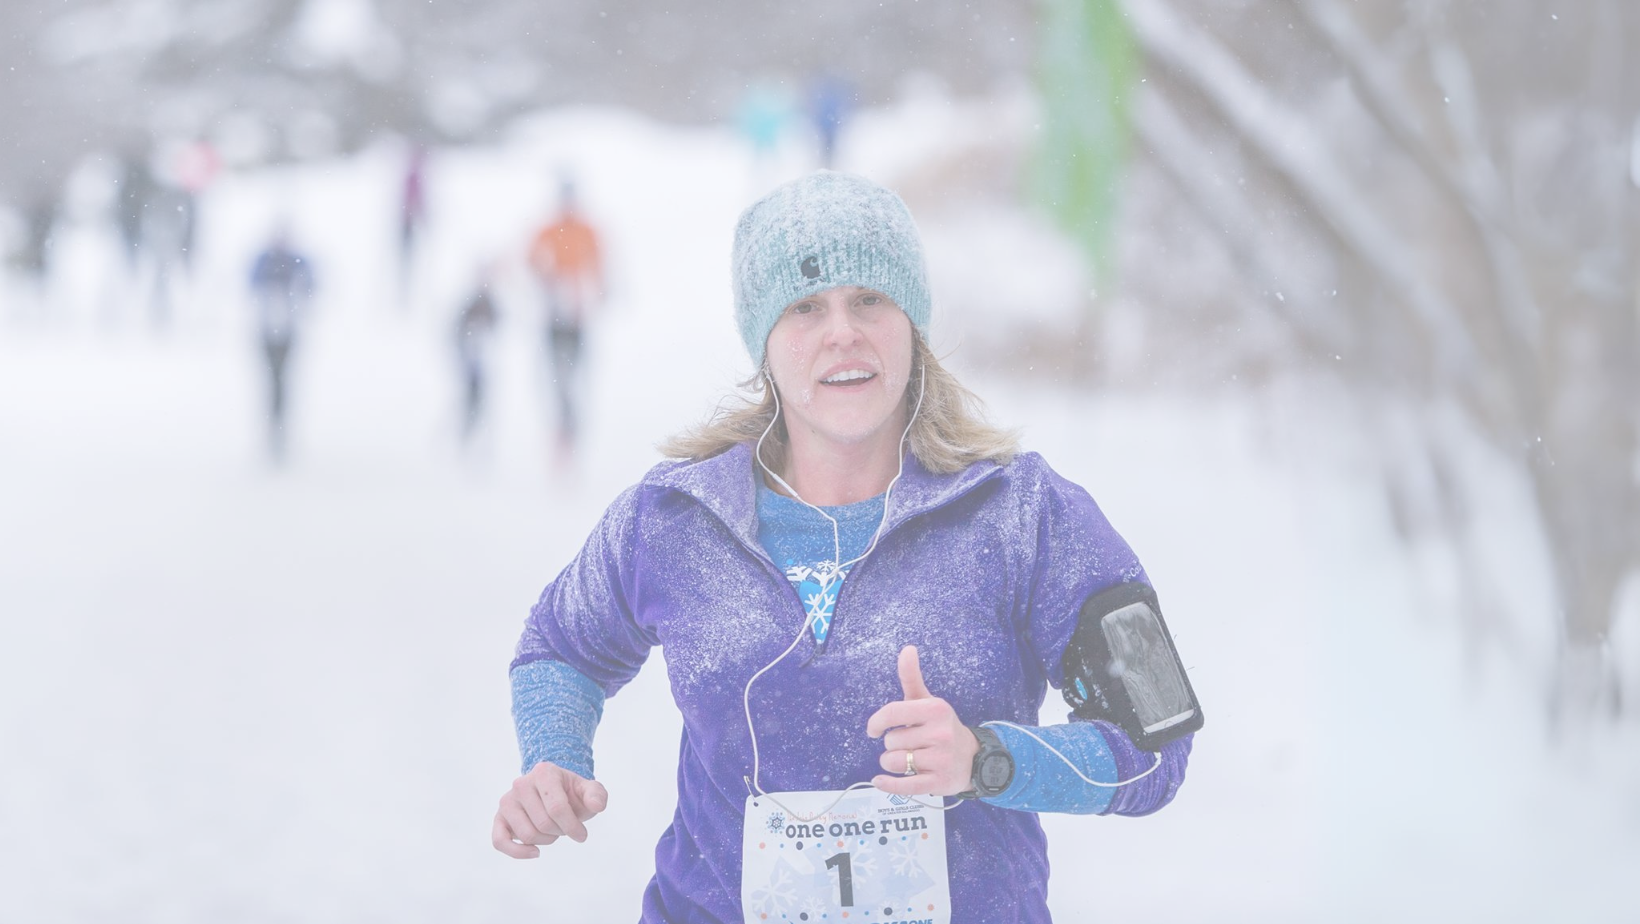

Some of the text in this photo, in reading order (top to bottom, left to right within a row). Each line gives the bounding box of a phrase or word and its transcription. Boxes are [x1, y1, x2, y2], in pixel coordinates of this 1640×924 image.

[785, 815, 927, 838] one one run
[825, 852, 854, 907] 1
